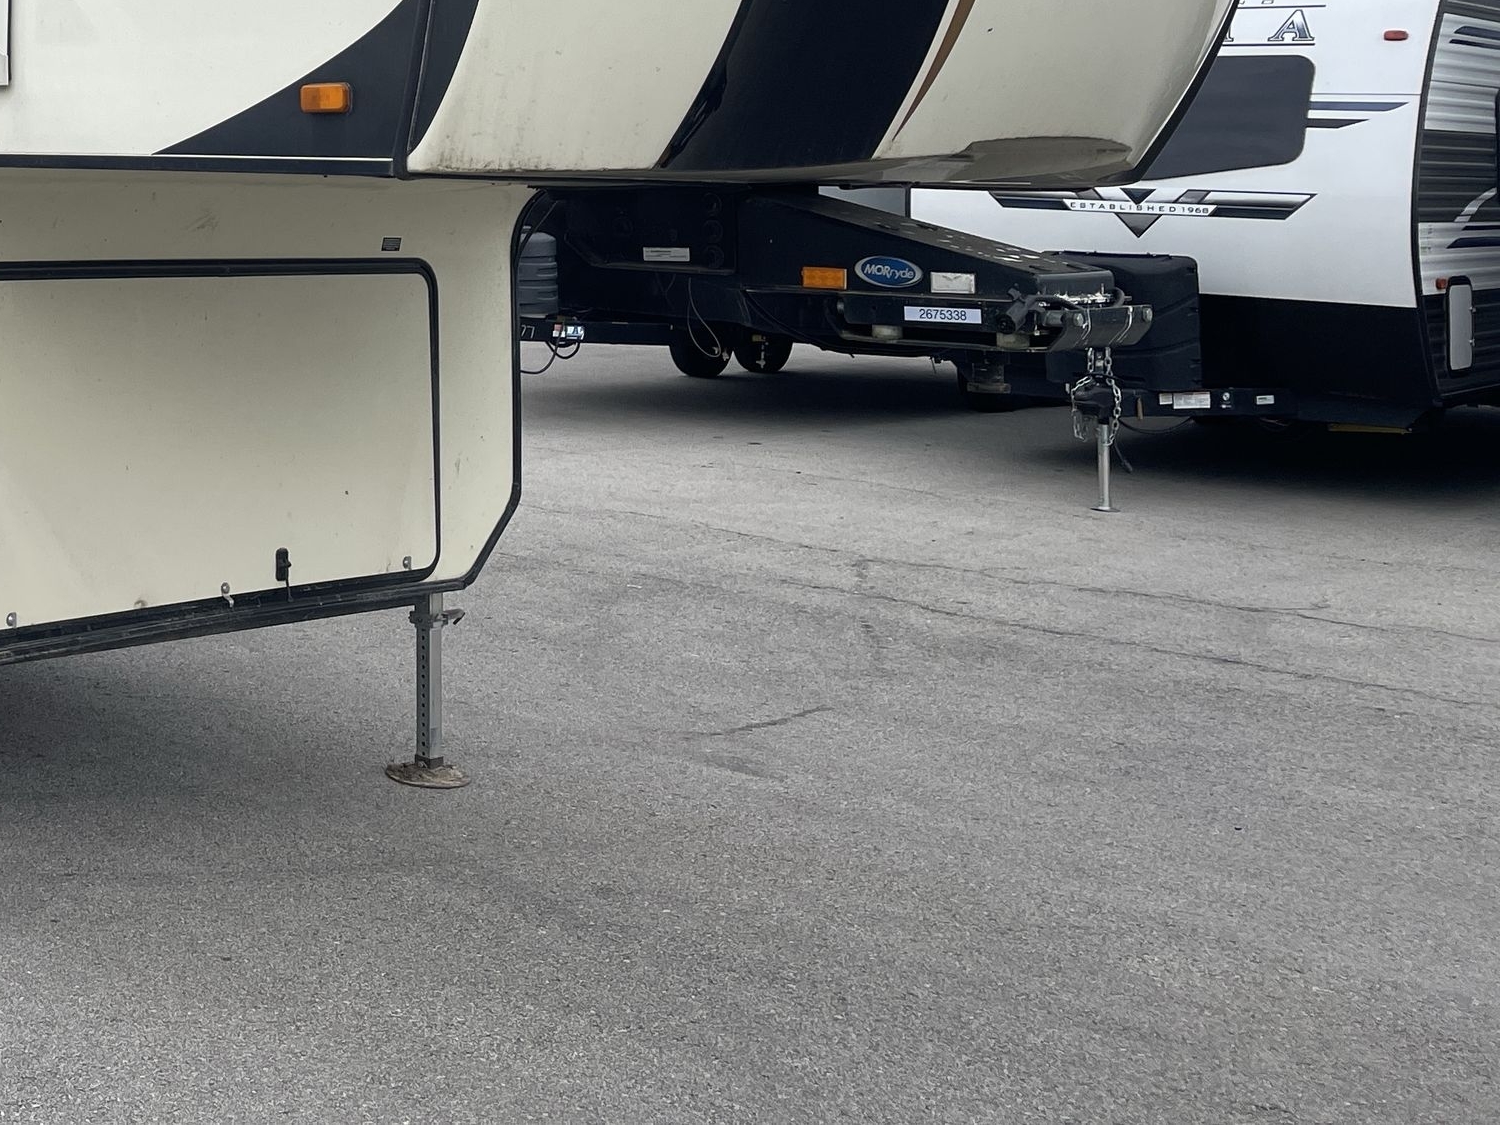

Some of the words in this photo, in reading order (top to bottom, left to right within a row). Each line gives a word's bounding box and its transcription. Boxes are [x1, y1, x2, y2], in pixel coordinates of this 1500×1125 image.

[1070, 201, 1177, 213] ESTABLISHED
[1181, 206, 1210, 214] 1968
[863, 263, 914, 280] MORryde
[918, 308, 967, 321] 2675338
